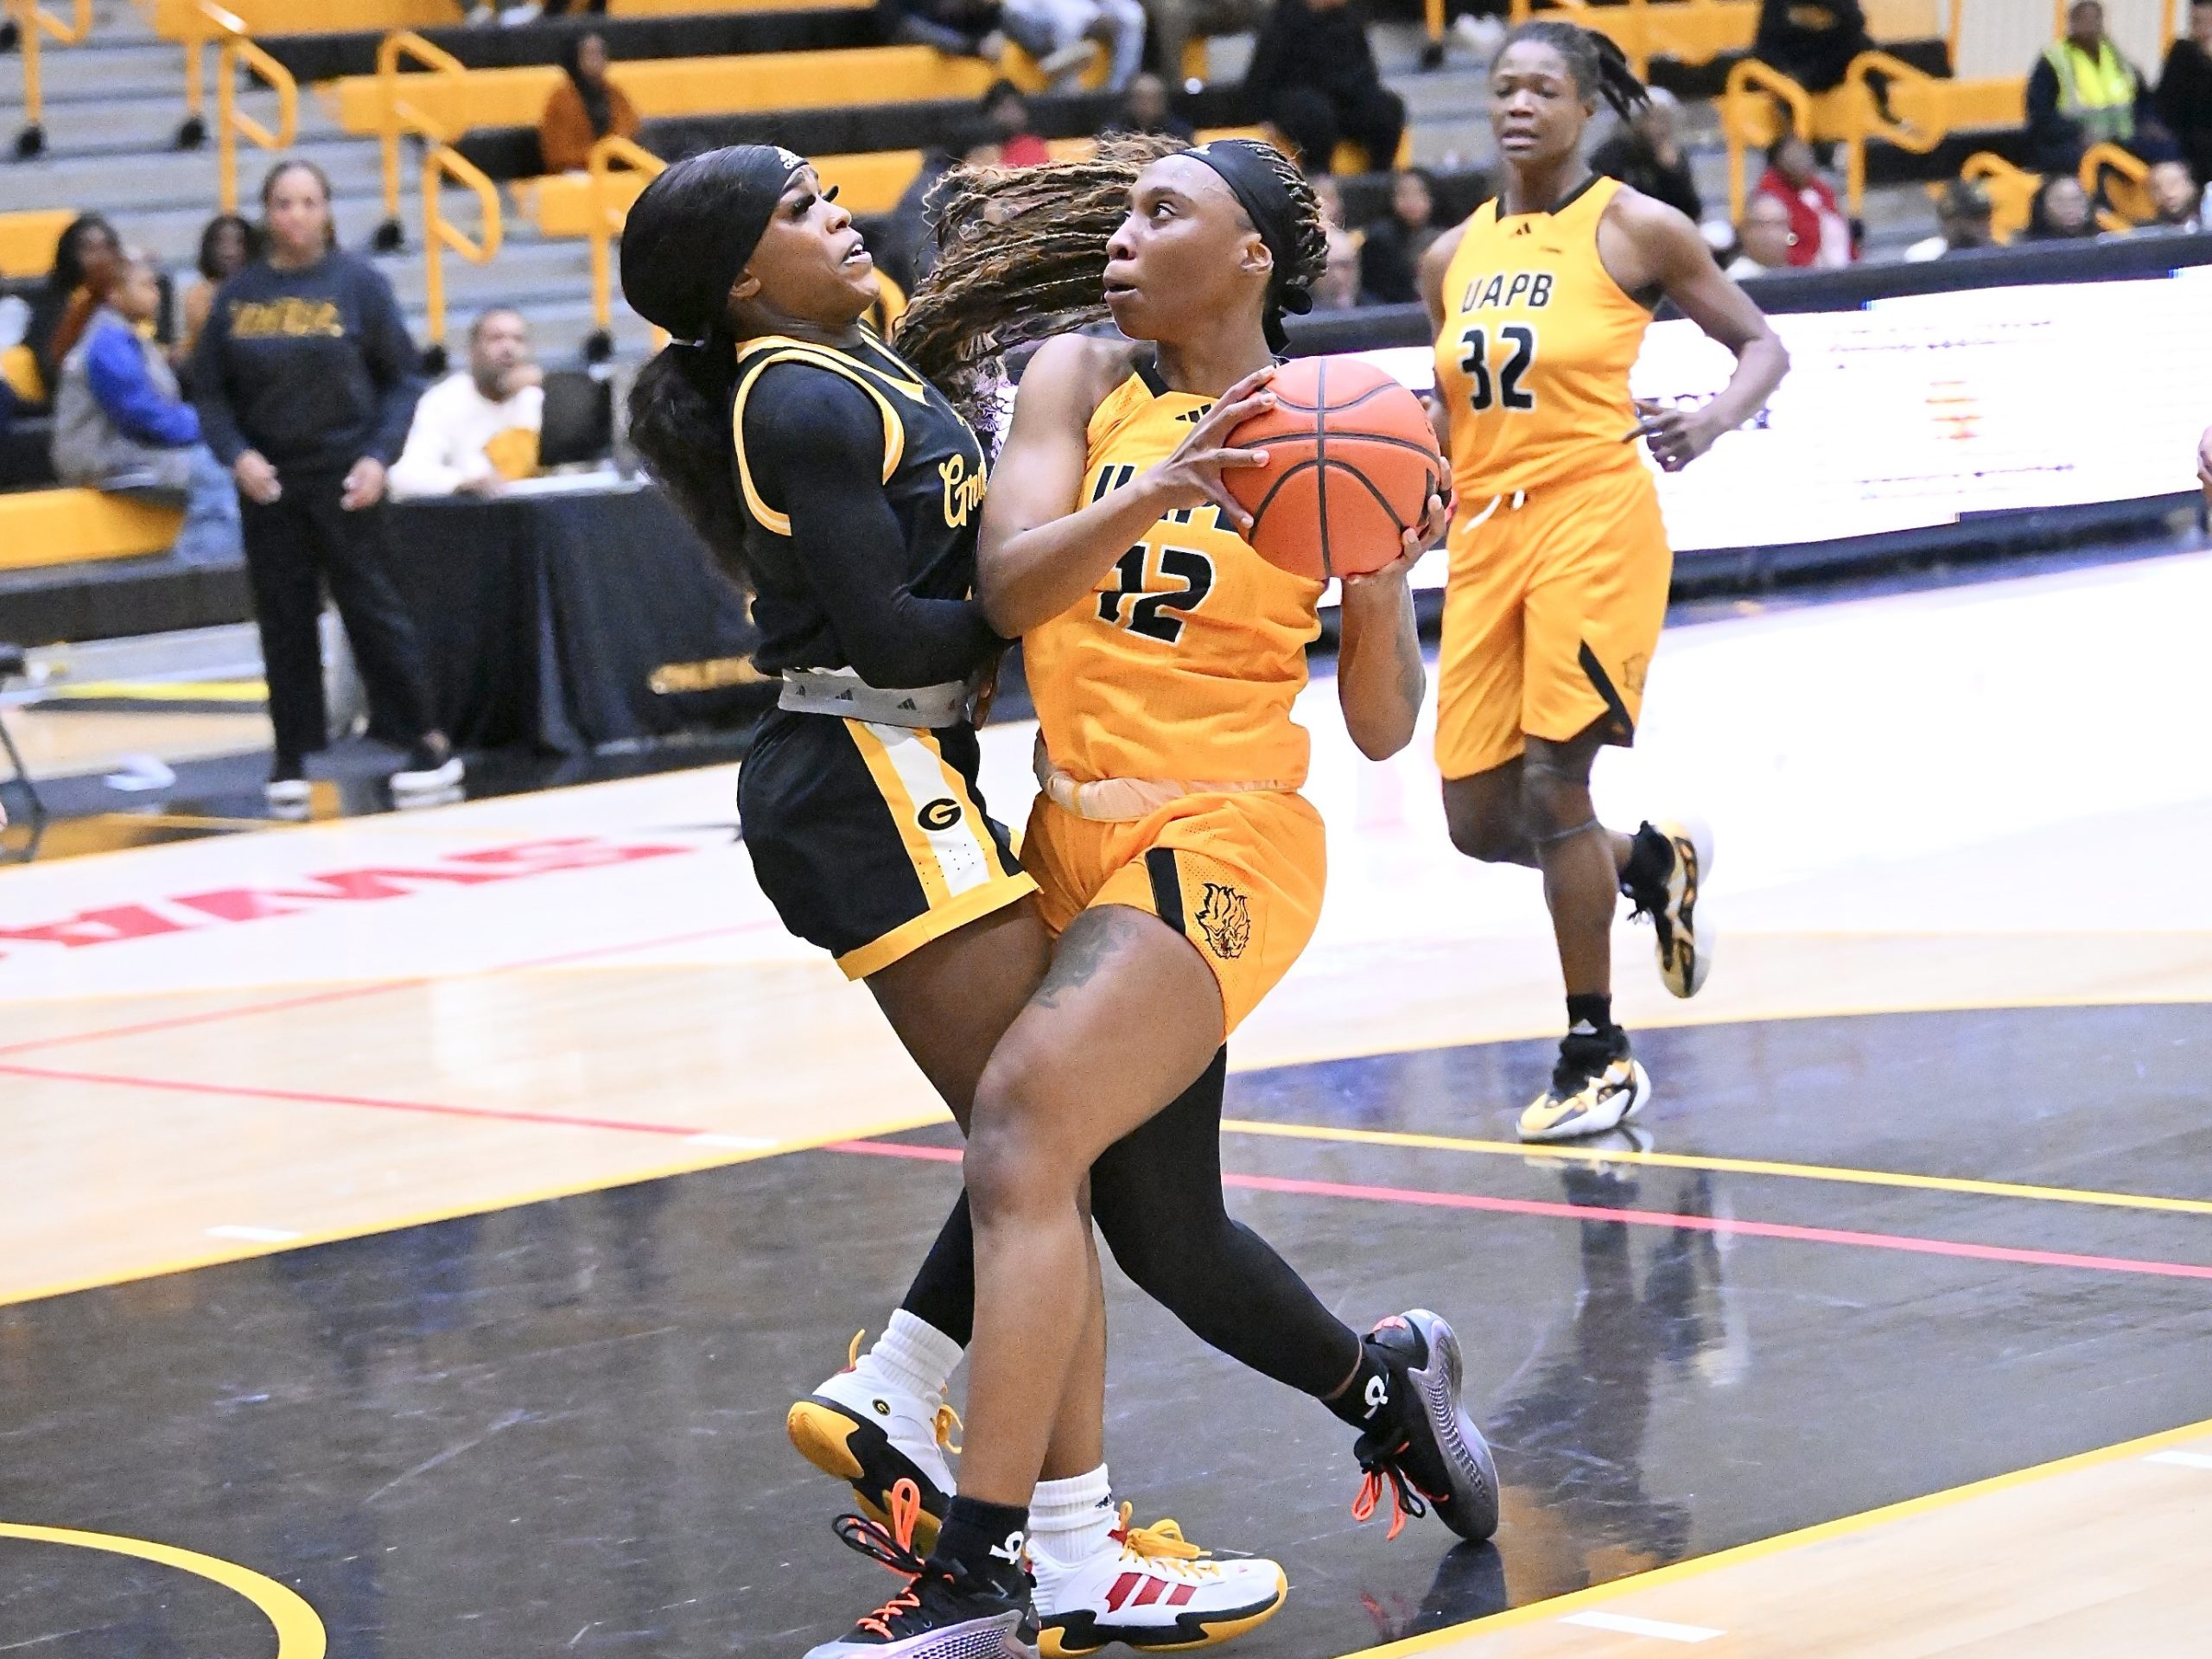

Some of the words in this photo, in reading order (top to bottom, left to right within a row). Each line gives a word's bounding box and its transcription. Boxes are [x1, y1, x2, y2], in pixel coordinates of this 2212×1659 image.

[1460, 273, 1554, 314] UAPB
[1459, 324, 1535, 411] 32
[1096, 541, 1217, 646] 12
[916, 797, 963, 832] G
